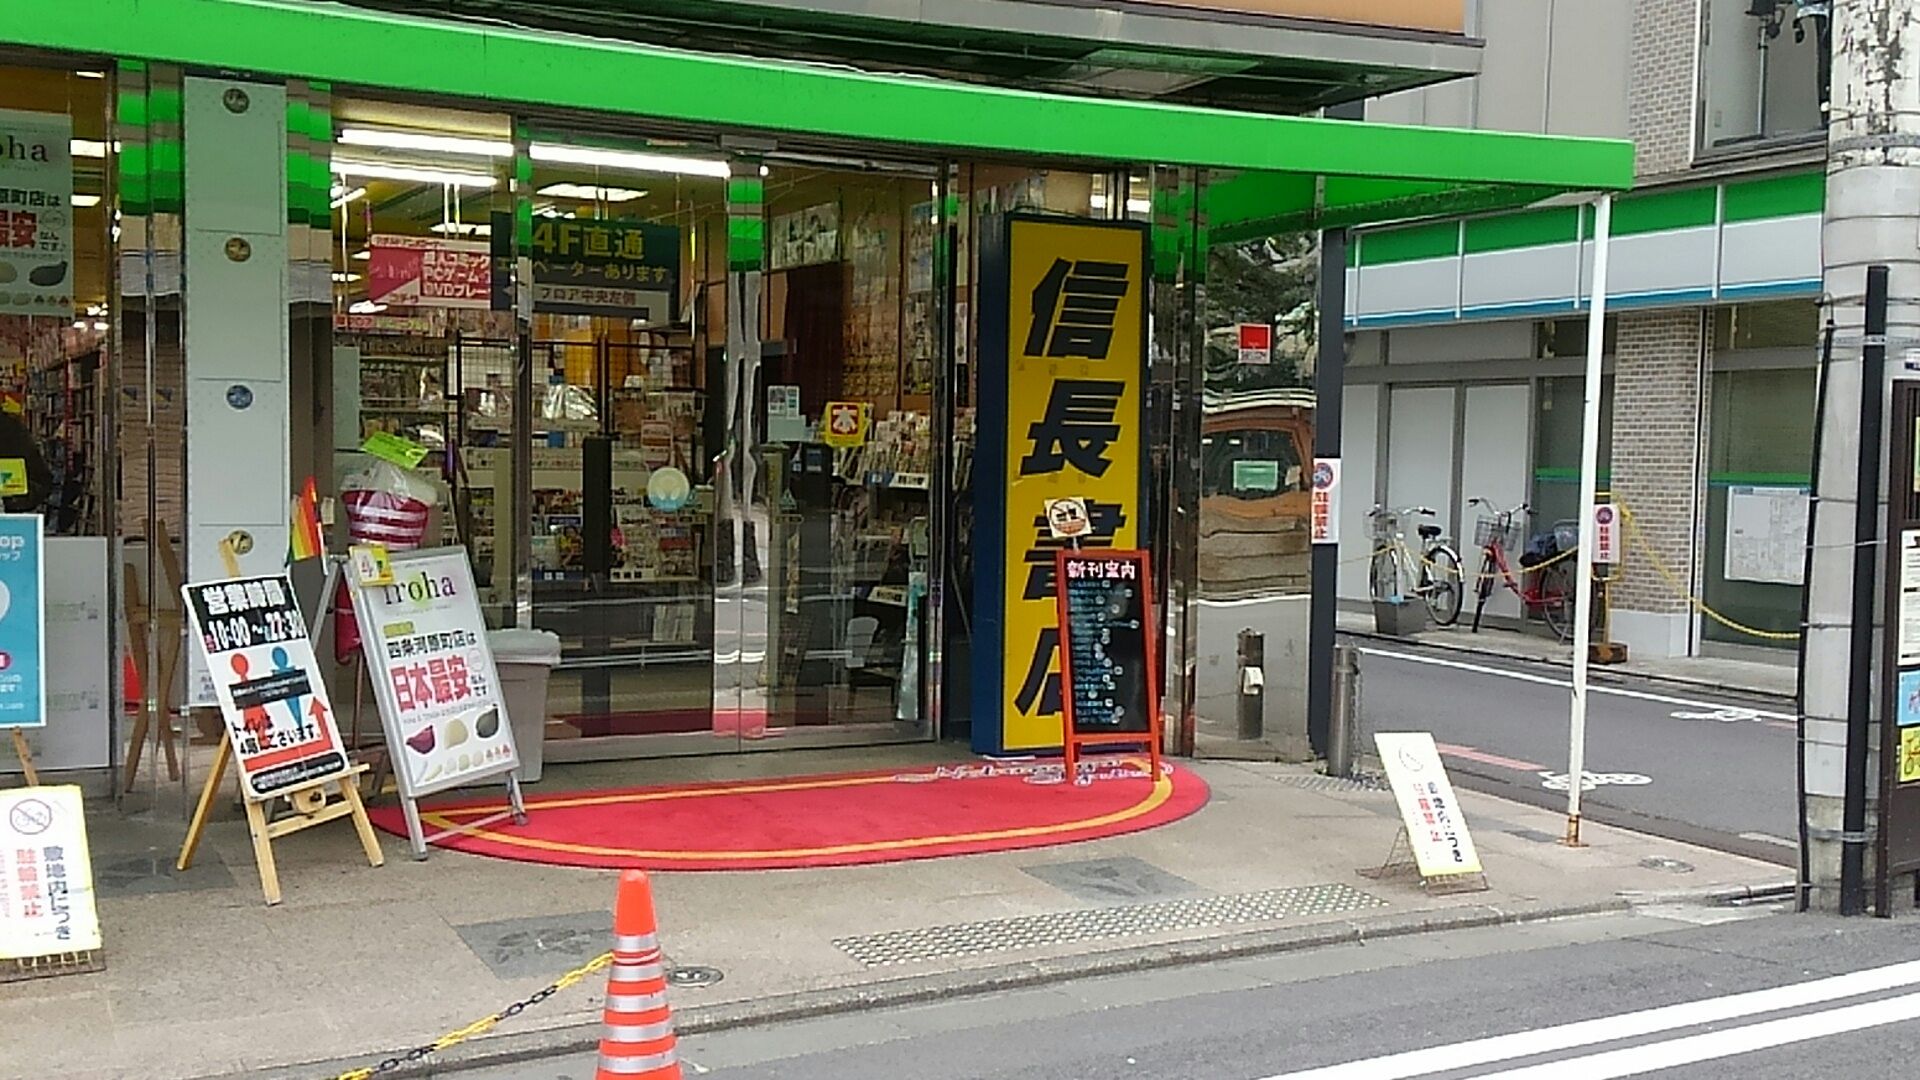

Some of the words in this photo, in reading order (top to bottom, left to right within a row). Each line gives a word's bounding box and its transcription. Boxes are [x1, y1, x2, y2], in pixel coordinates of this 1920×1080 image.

[0, 134, 49, 163] ha
[533, 222, 645, 260] 4F直通
[423, 265, 490, 284] PCゲーム・
[497, 256, 669, 283] エベーターあります
[423, 281, 490, 297] DVDプレー
[541, 286, 636, 306] フロア中央左側
[1066, 560, 1136, 580] 新刊案内
[202, 579, 285, 615] 営業時間
[386, 630, 477, 659] 四条河原町店は
[390, 654, 472, 713] 日本最安
[43, 845, 71, 940] 敷地内につき
